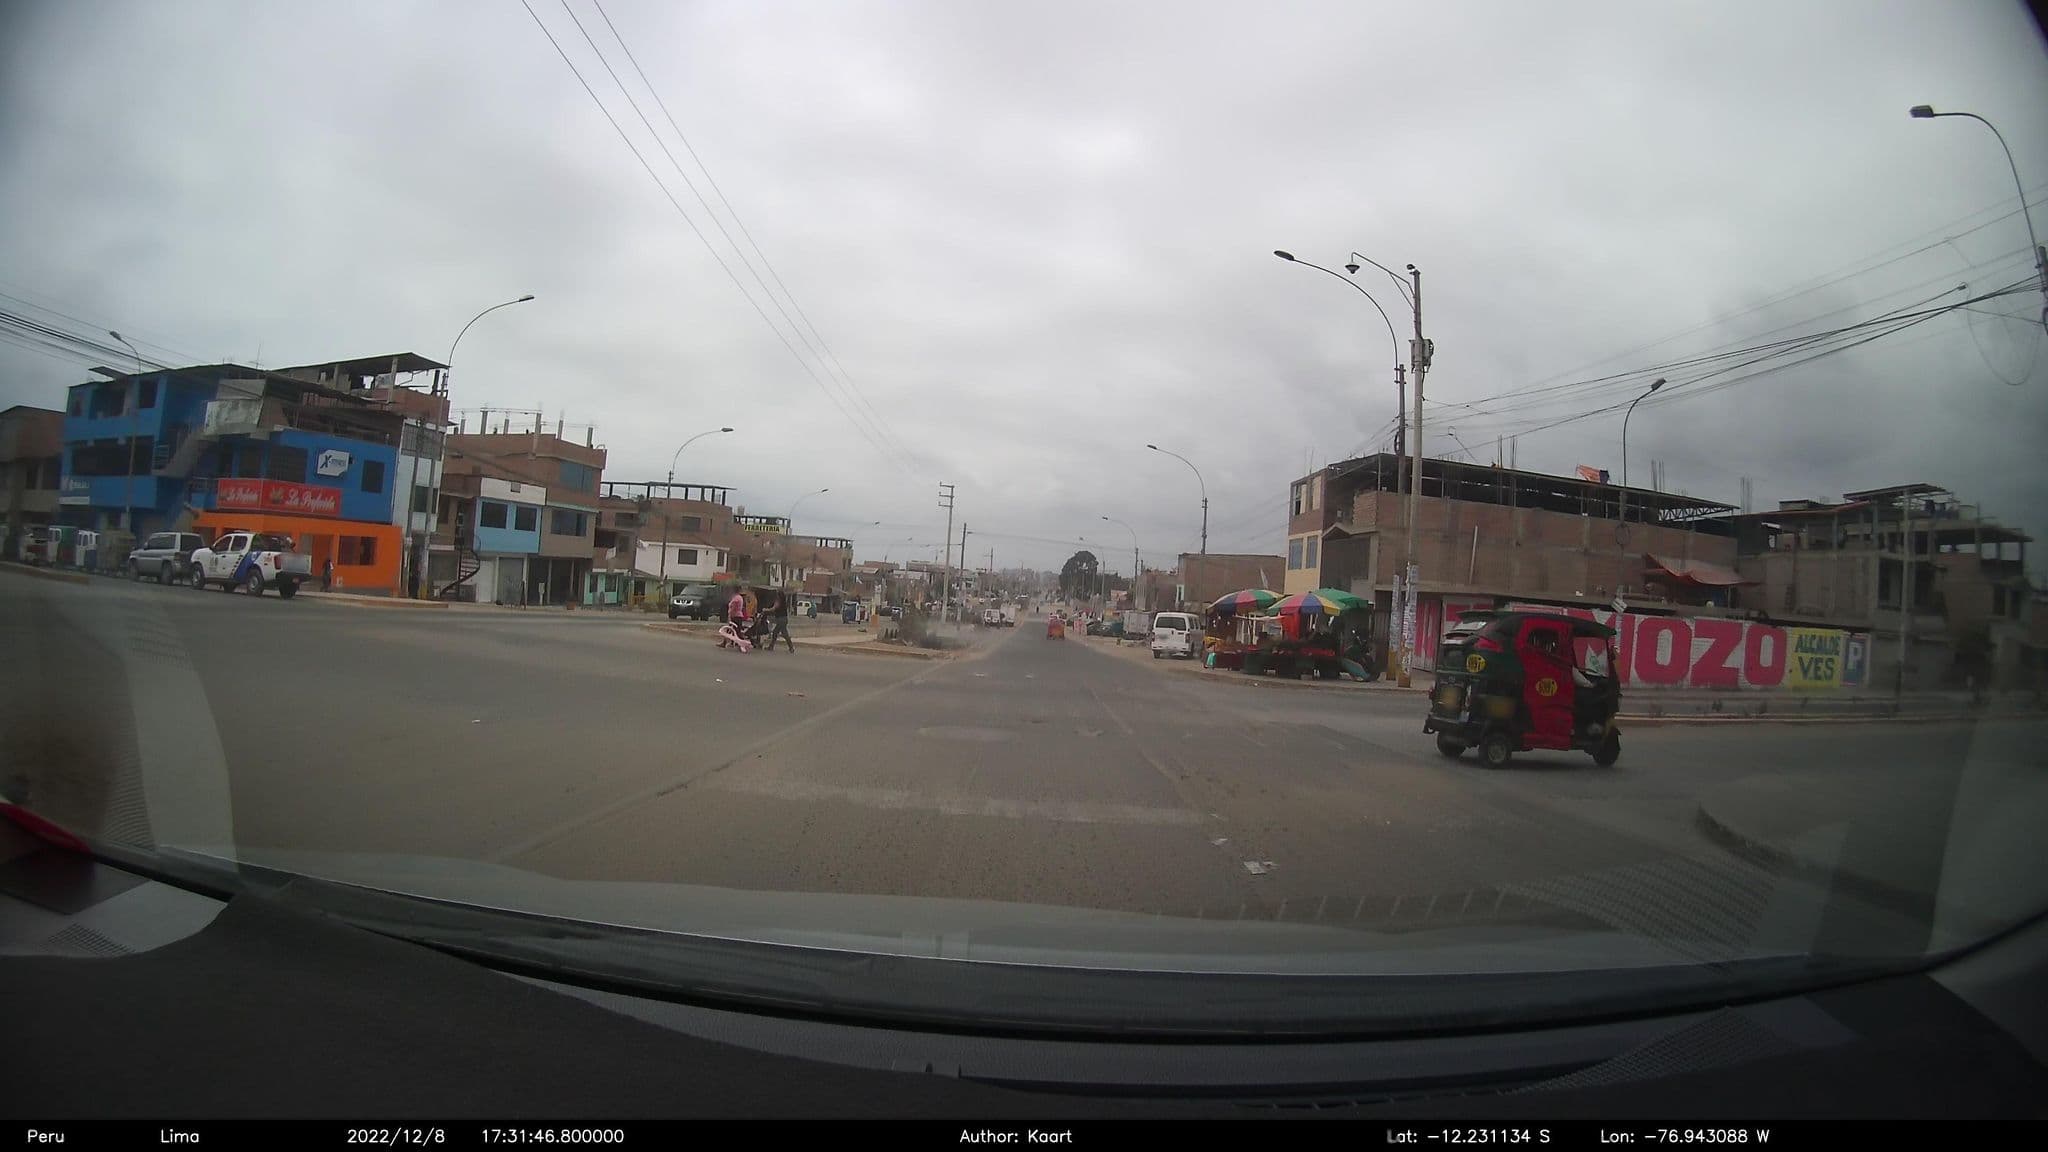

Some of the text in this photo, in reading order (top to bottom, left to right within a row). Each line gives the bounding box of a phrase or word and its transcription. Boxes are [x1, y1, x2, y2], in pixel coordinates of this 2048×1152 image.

[285, 487, 300, 506] La
[1794, 633, 1841, 657] ALCALDE
[1797, 655, 1836, 681] VES
